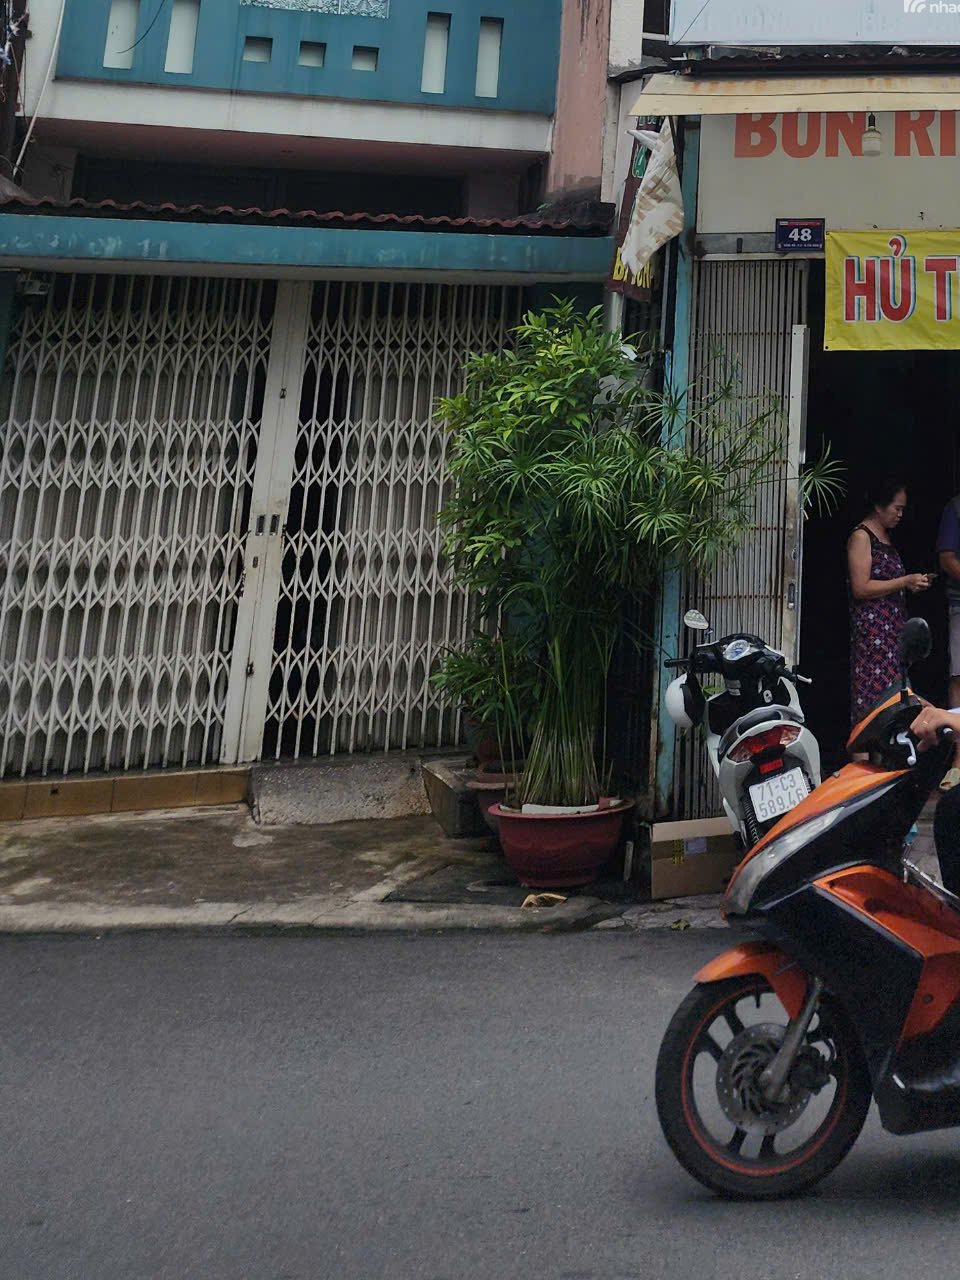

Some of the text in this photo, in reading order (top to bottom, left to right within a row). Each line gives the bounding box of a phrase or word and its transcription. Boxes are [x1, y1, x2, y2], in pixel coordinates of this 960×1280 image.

[788, 228, 812, 241] 48
[843, 234, 917, 321] HỦ
[757, 773, 797, 801] 71-C3
